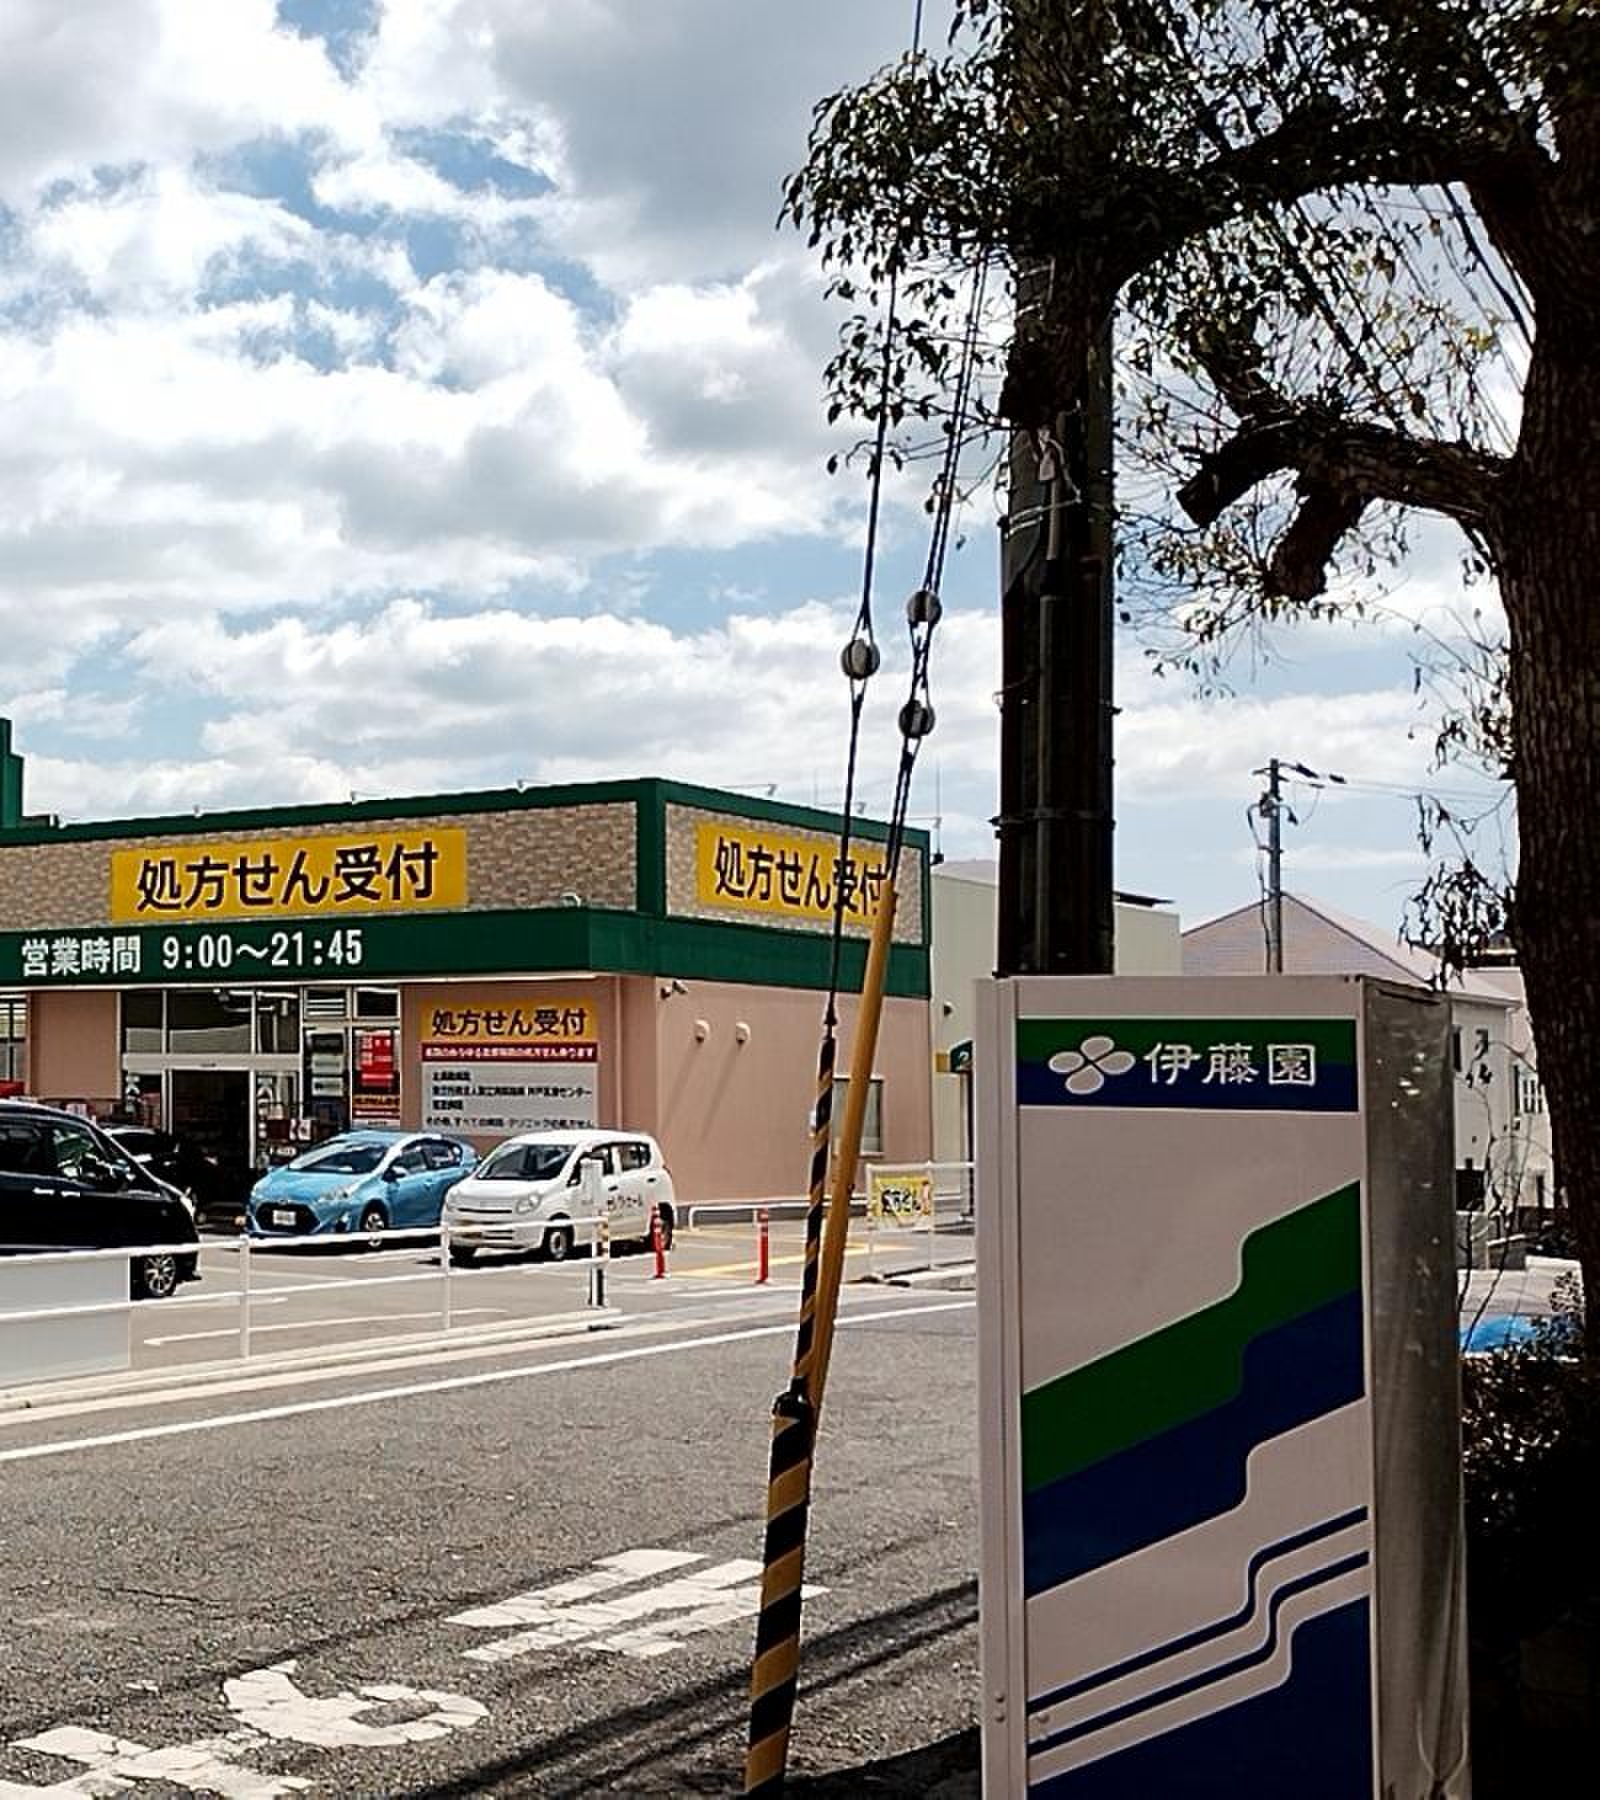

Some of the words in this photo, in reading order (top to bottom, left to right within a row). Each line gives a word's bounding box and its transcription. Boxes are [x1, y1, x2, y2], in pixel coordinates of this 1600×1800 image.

[136, 841, 439, 913] 処方せん受付
[21, 935, 141, 977] 営業時間
[432, 1008, 586, 1036] 処方せん受付
[1143, 1042, 1317, 1086] 伊藤園
